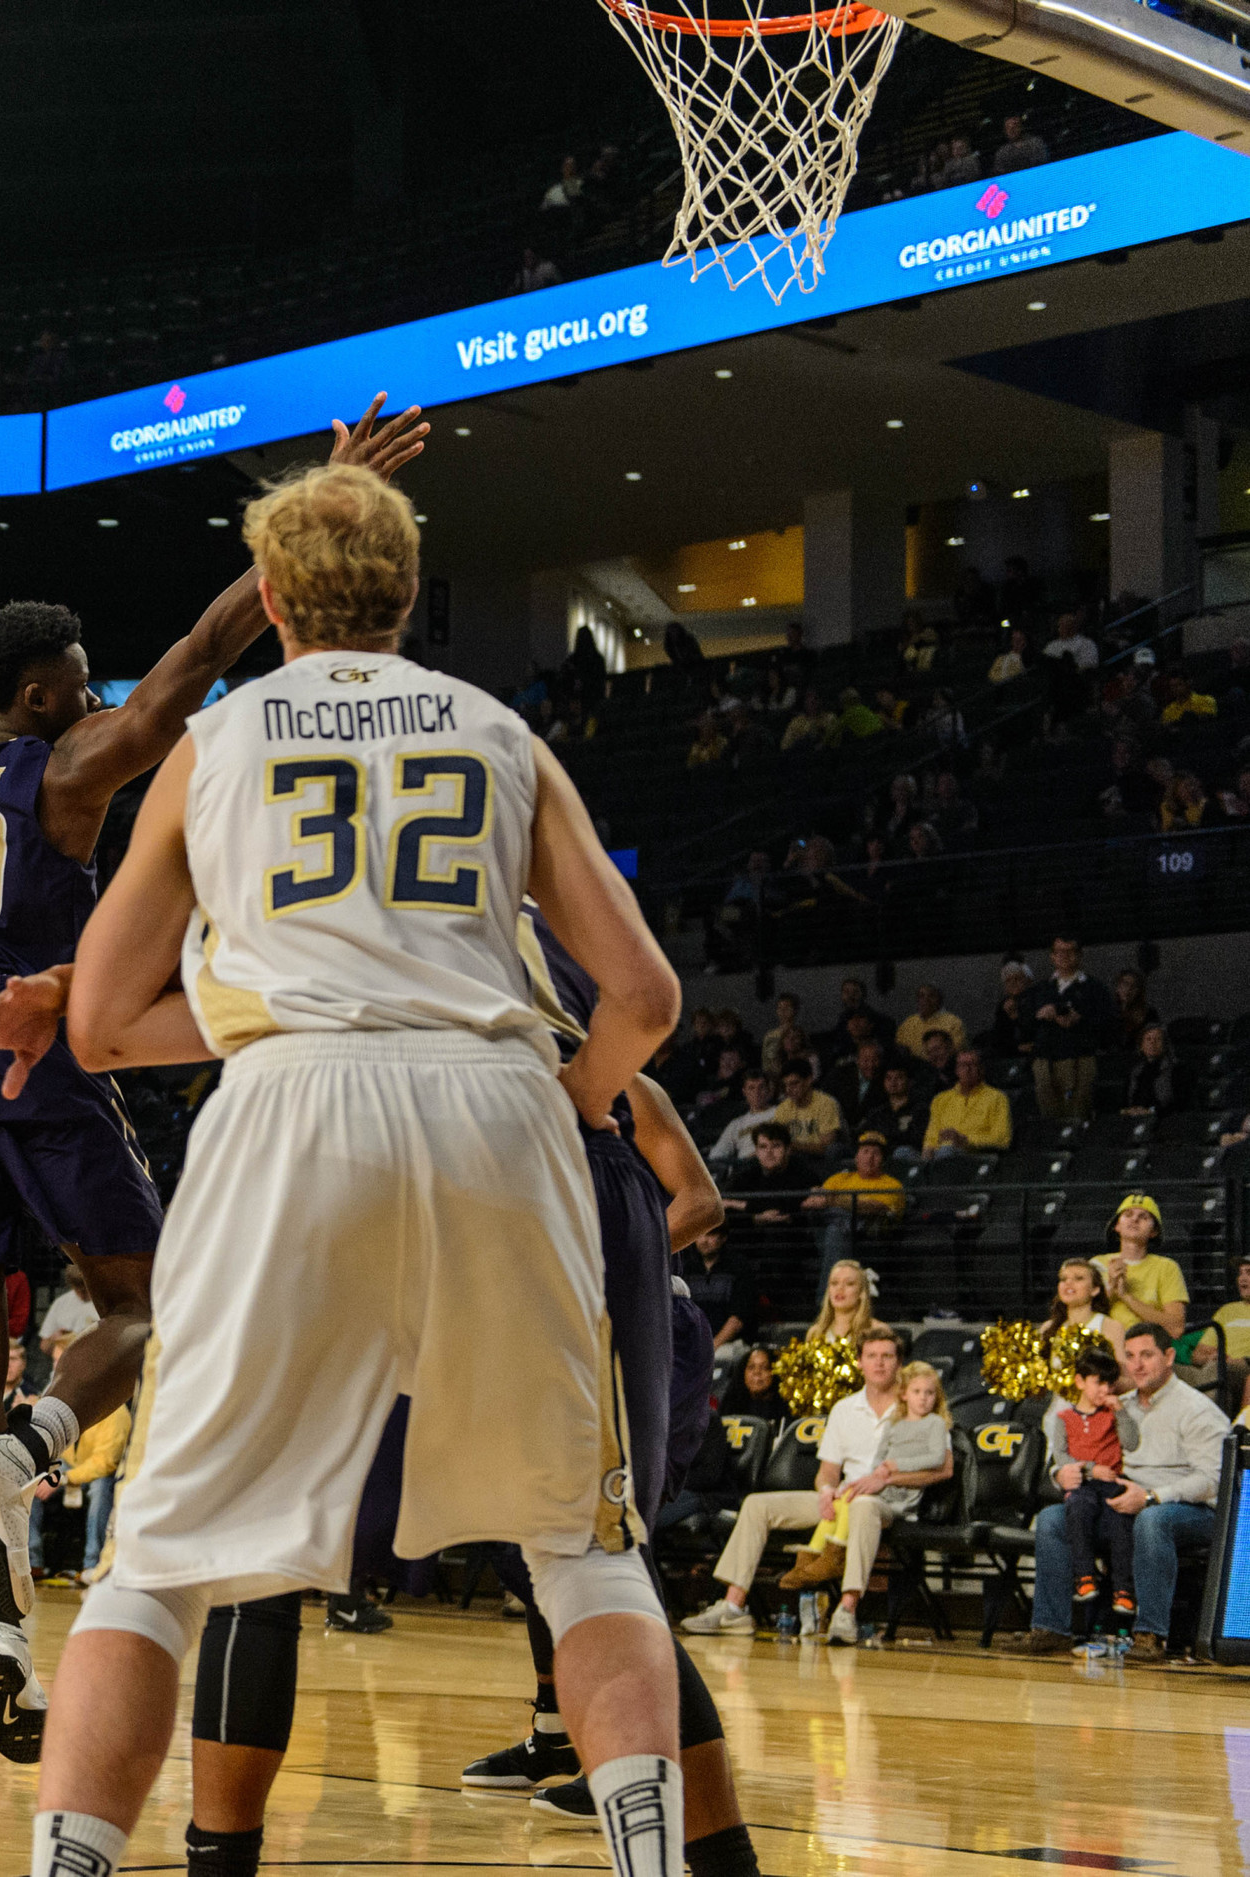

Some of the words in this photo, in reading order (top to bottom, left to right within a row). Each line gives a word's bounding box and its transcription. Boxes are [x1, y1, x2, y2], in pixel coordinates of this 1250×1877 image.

[456, 331, 518, 370] Visit
[524, 304, 648, 362] gucu.org
[264, 694, 457, 741] McCORMICK
[263, 749, 495, 922] 32
[1158, 852, 1193, 872] 109
[977, 1424, 1024, 1457] GT
